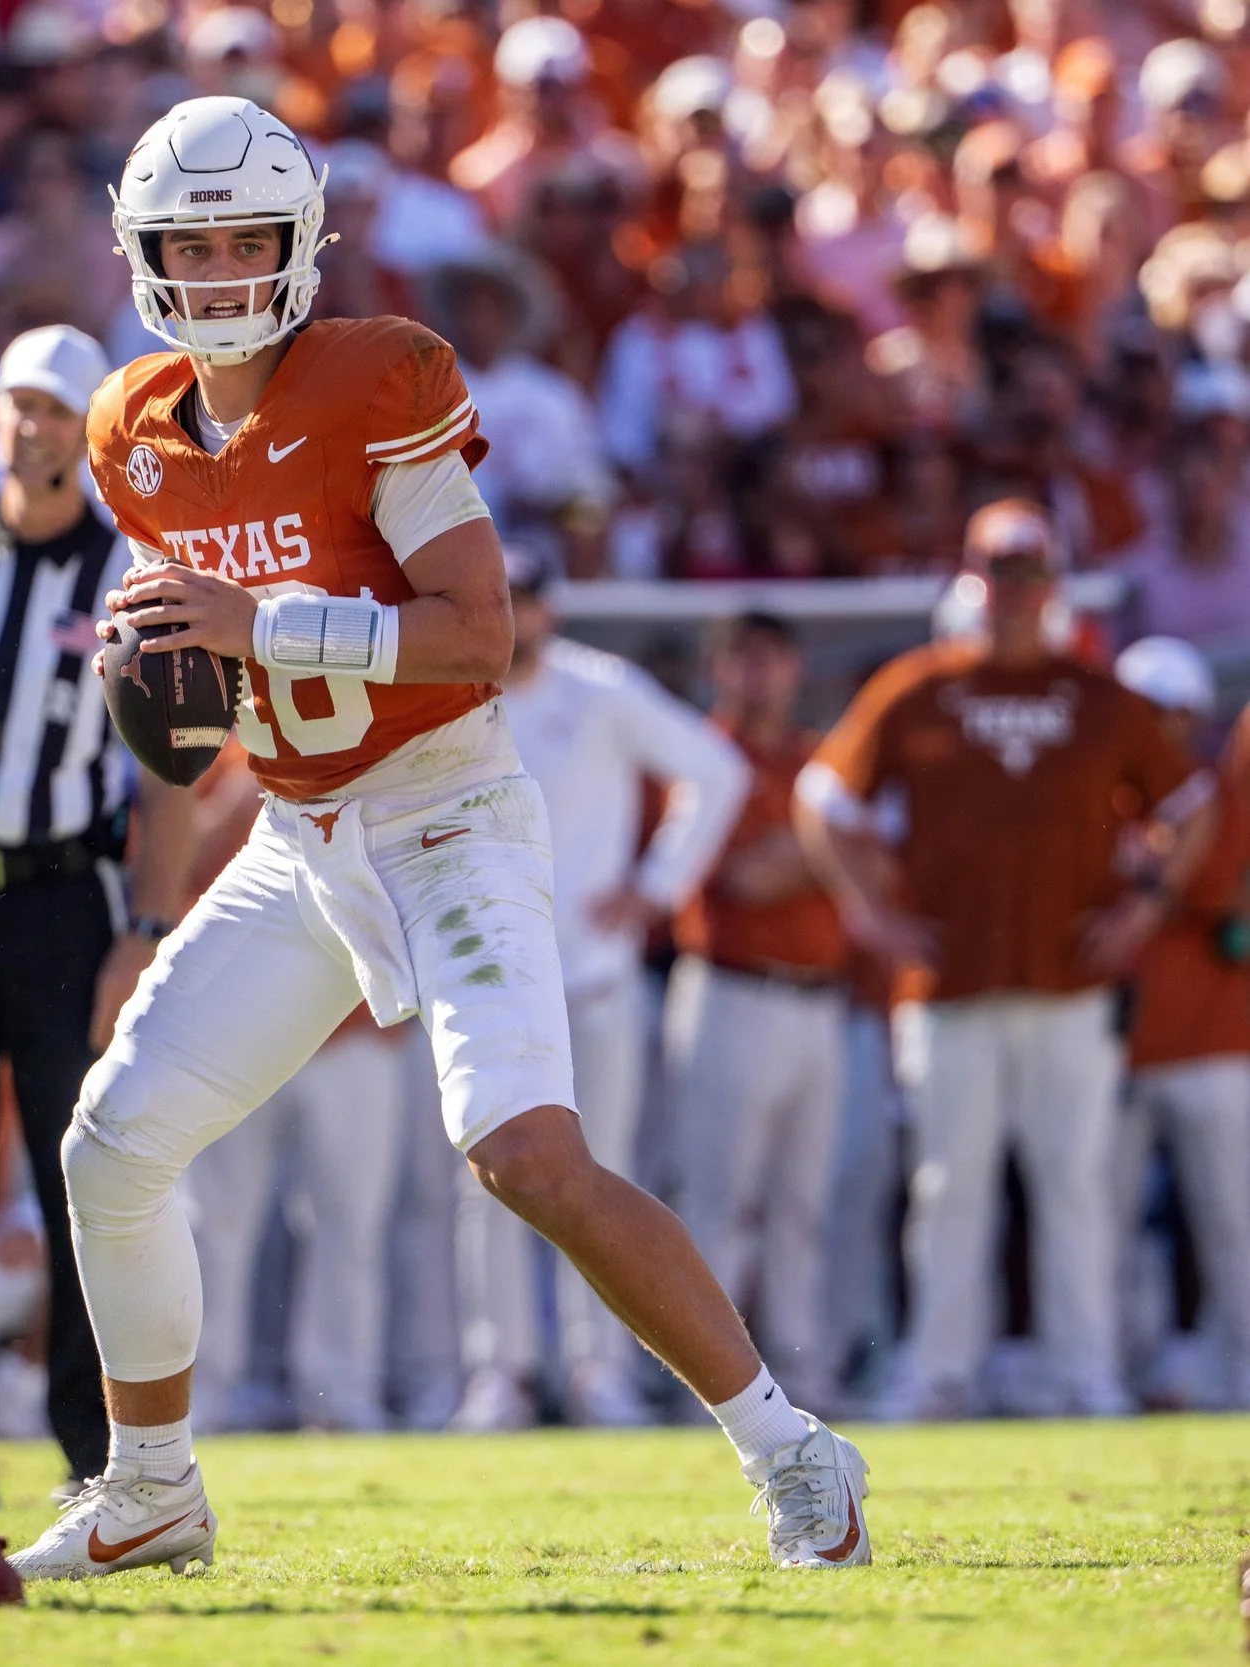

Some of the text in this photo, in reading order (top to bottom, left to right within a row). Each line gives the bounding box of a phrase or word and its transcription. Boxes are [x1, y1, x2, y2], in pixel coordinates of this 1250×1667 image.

[189, 189, 232, 203] HORNS
[129, 447, 160, 493] SEC
[160, 512, 311, 580] TEXAS
